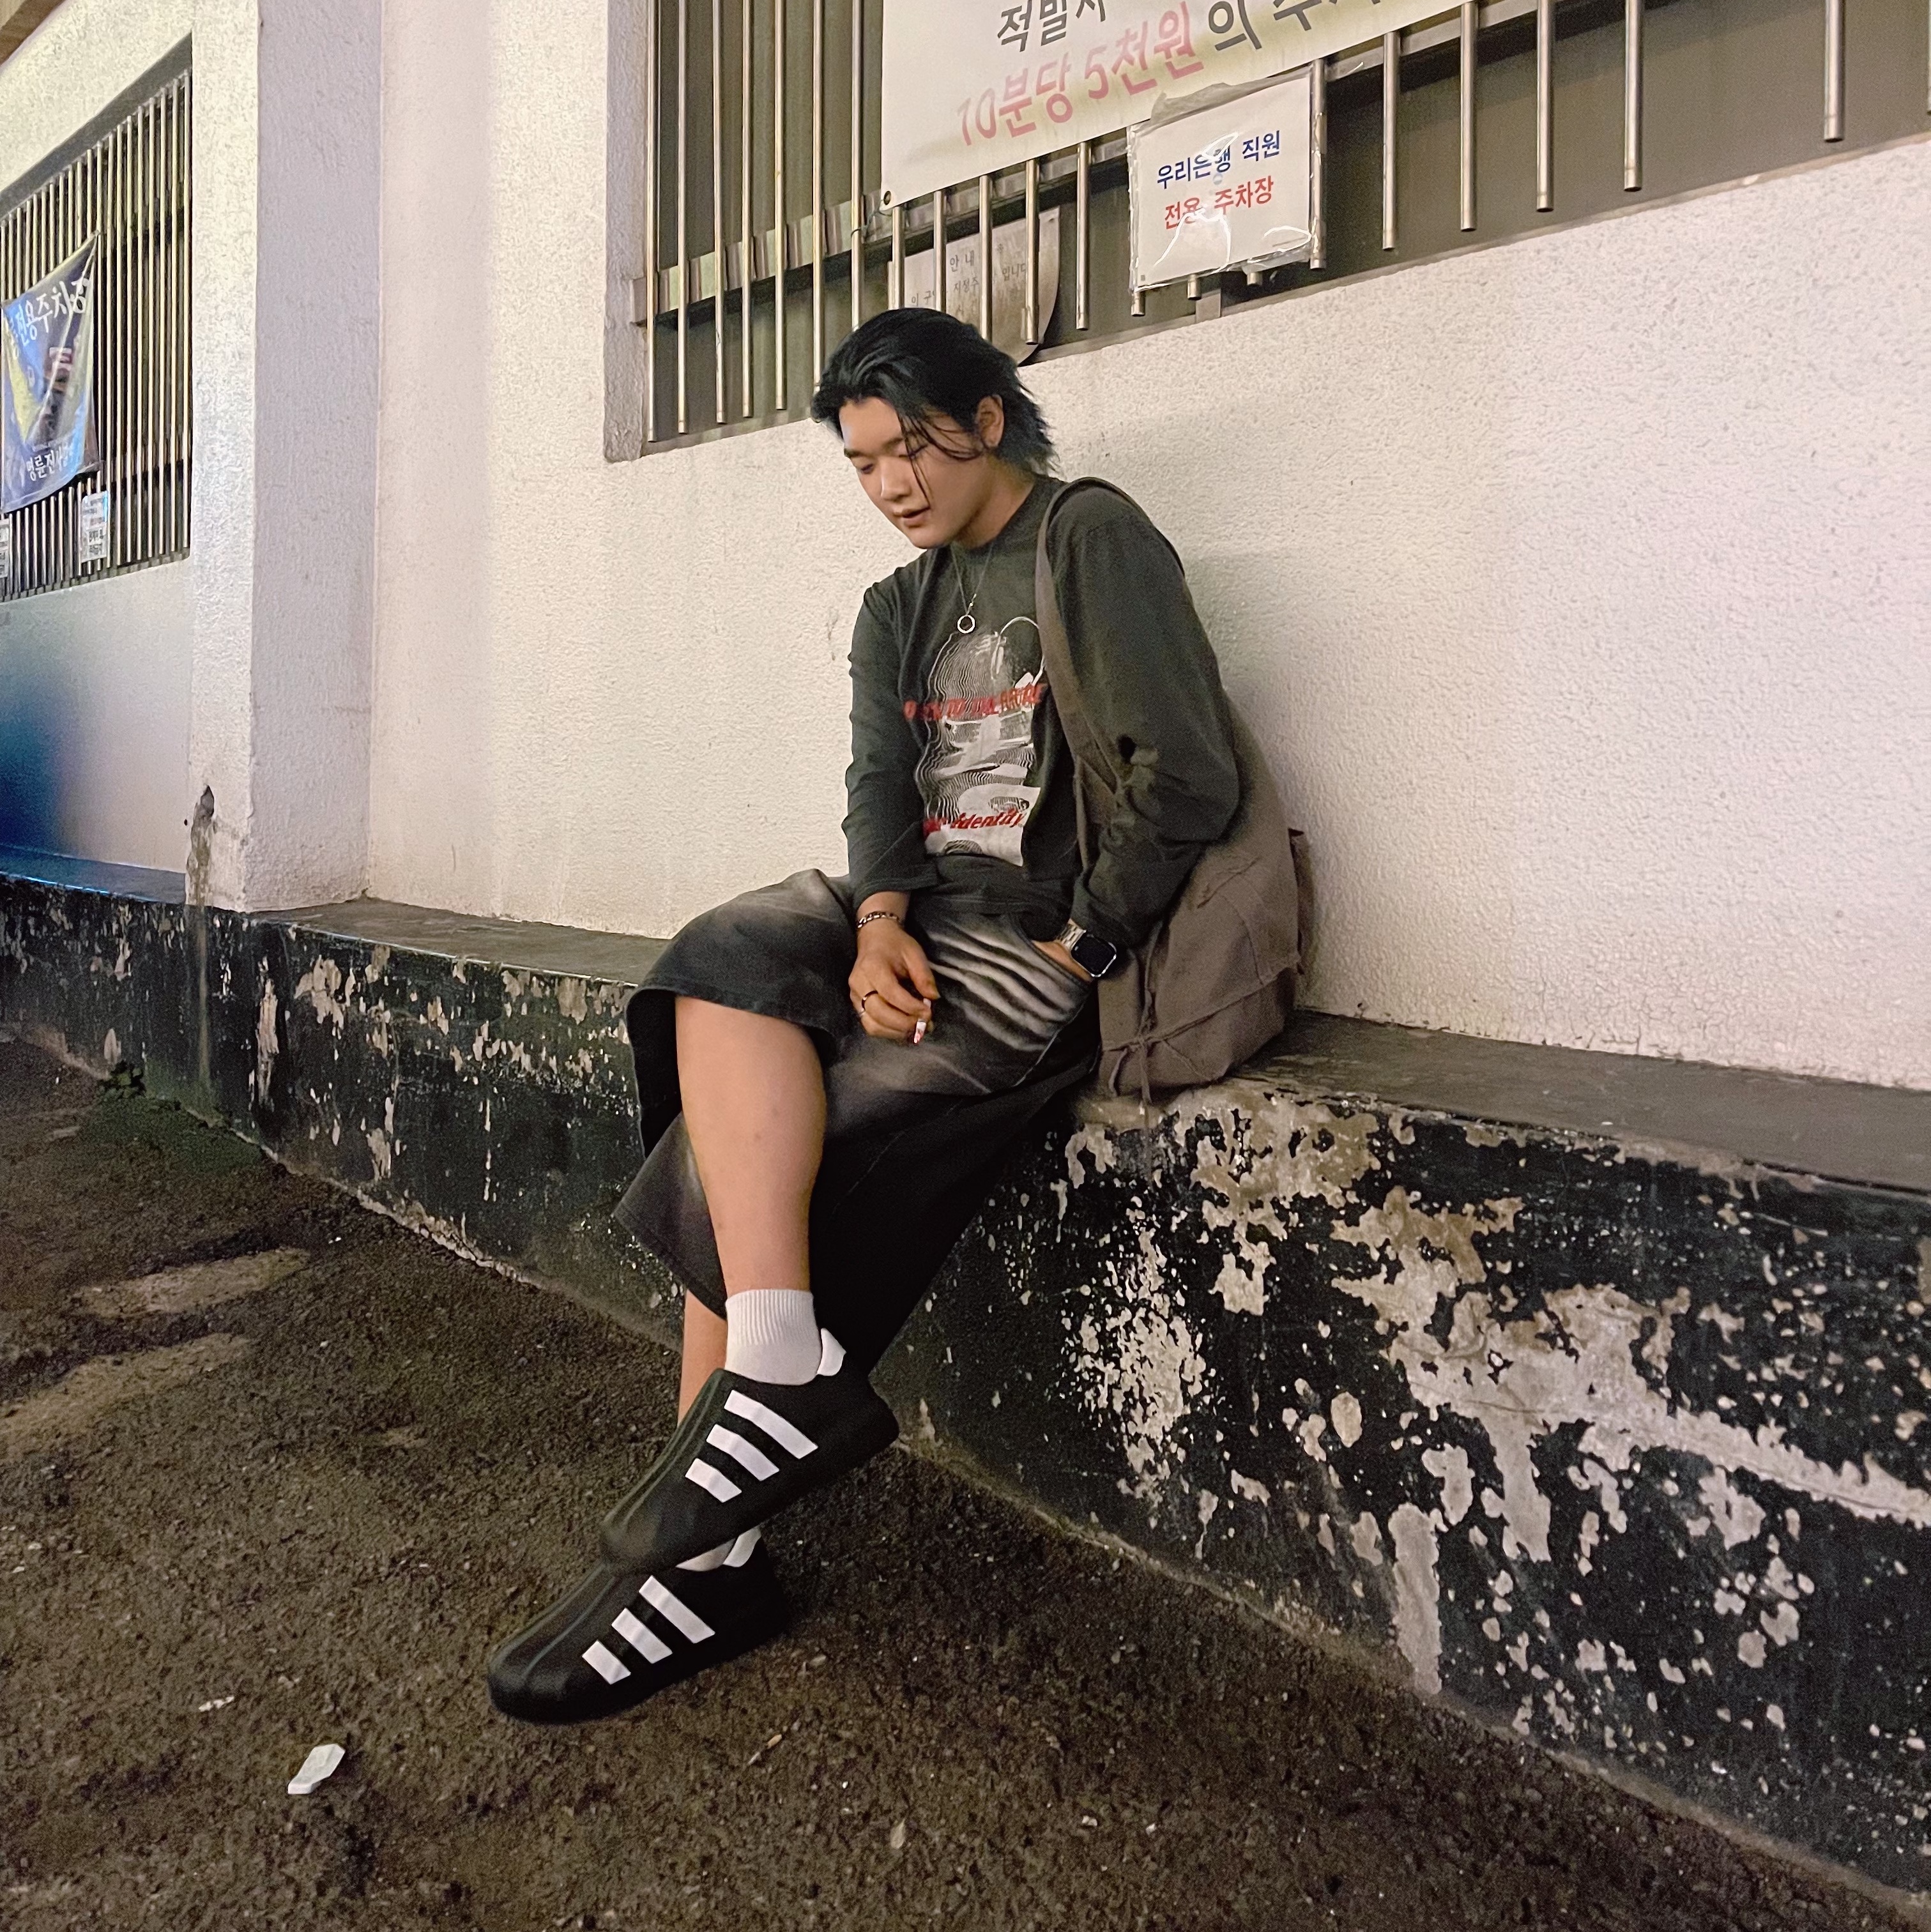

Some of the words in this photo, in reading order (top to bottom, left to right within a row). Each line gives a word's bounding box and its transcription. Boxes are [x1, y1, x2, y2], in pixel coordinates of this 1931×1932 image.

[958, 52, 1073, 146] 10분당
[1085, 1, 1204, 100] 5천원
[1157, 144, 1231, 189] 우리은행
[1242, 130, 1280, 162] 직원
[1164, 197, 1202, 230] 전용
[1214, 175, 1274, 215] 주차장
